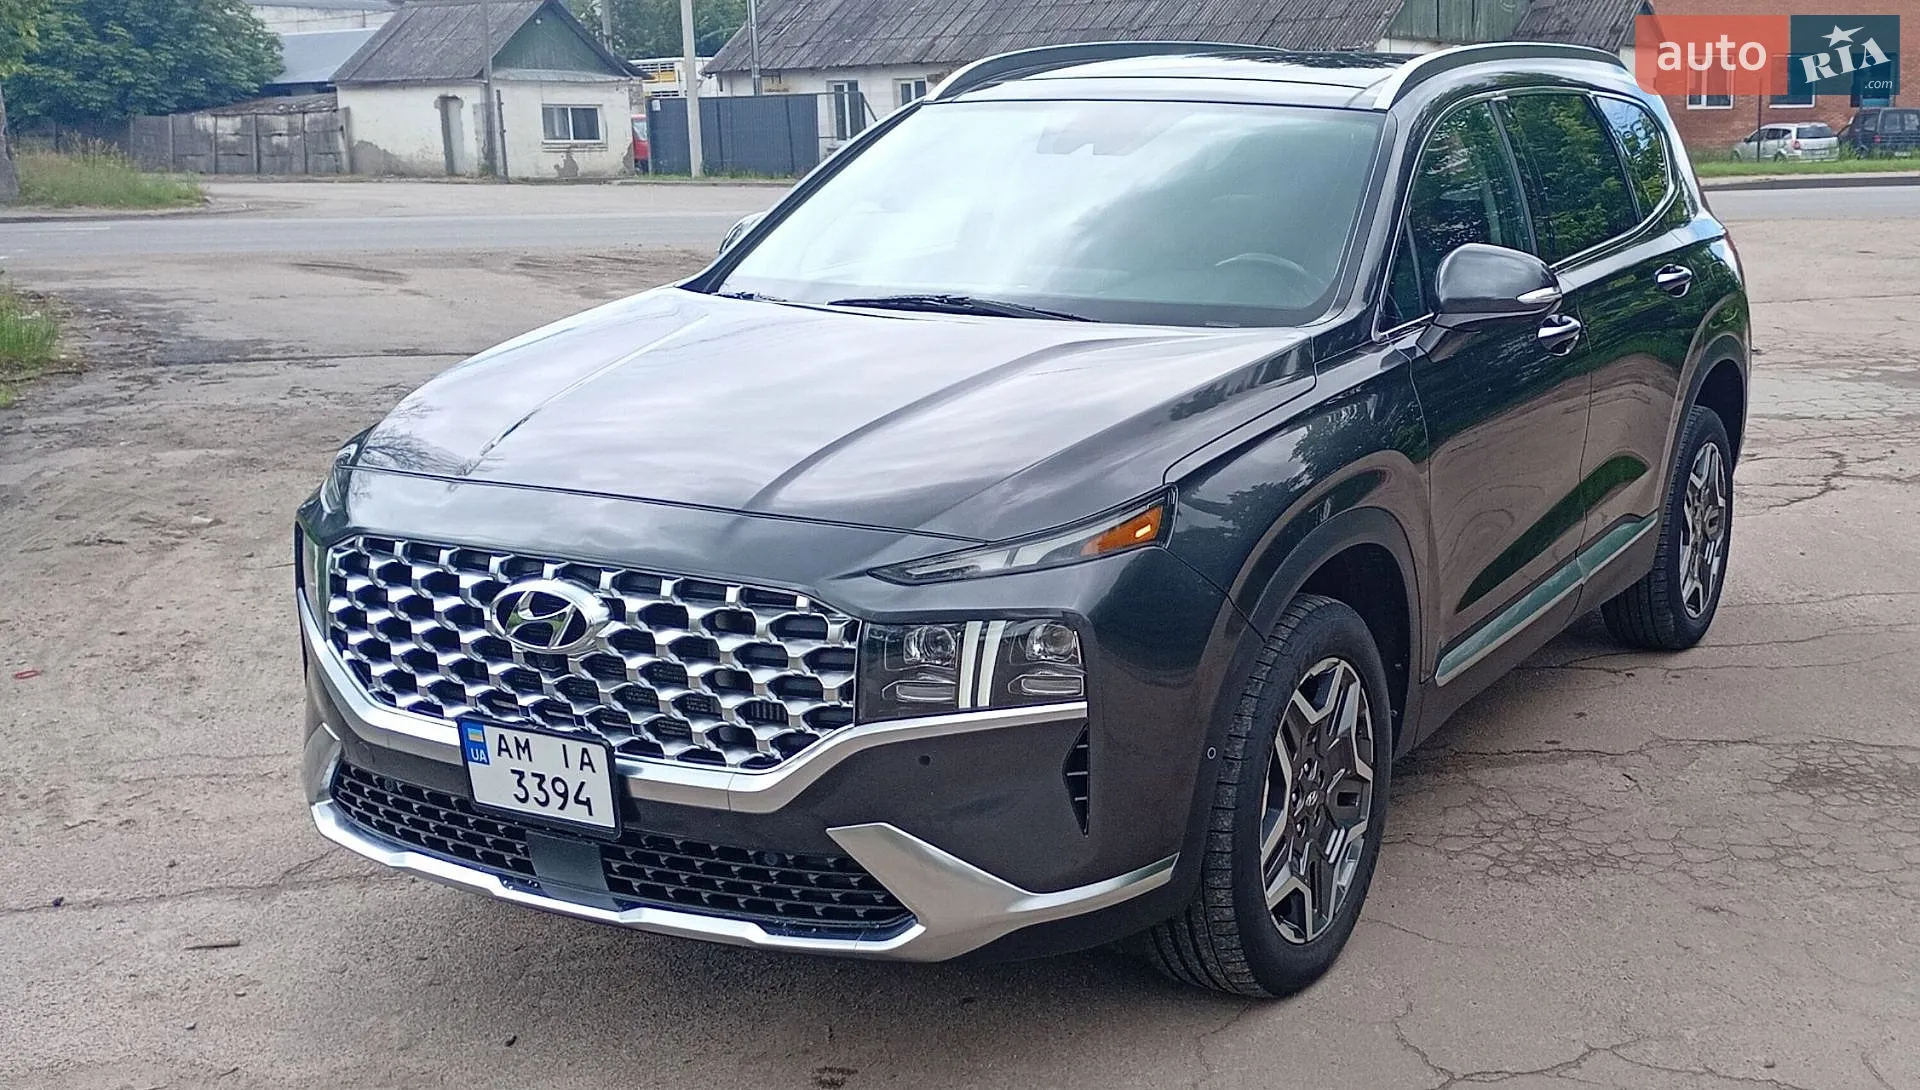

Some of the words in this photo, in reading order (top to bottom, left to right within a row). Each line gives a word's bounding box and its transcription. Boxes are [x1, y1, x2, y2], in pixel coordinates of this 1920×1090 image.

[470, 748, 488, 763] UA
[497, 733, 533, 763] AM
[562, 744, 597, 773] IA
[510, 768, 594, 816] 3394
